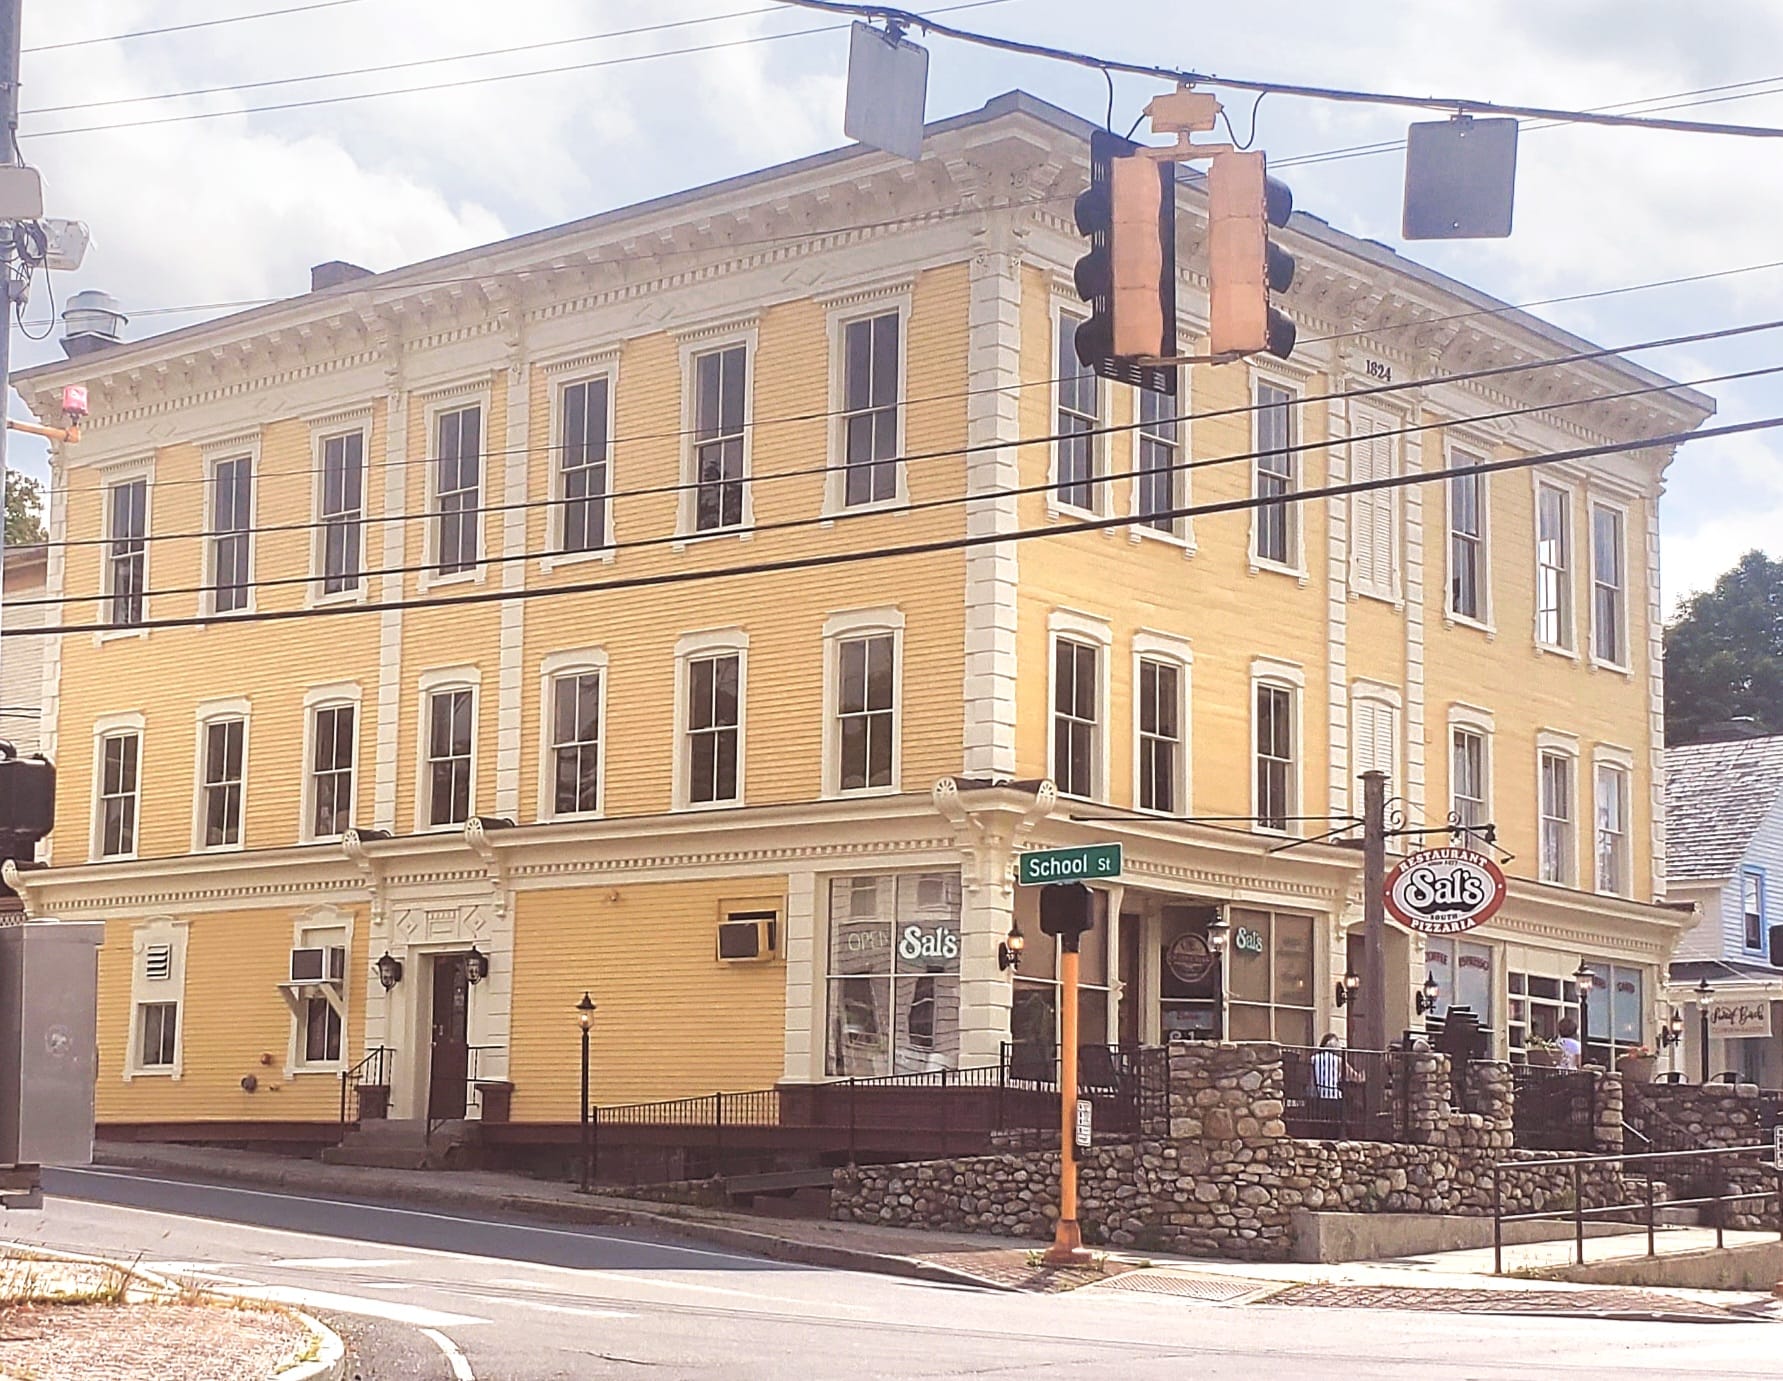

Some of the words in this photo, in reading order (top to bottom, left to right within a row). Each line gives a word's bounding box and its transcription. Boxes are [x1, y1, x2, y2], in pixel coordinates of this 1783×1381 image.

[1366, 360, 1391, 381] 1824
[1029, 854, 1087, 877] School
[1098, 858, 1111, 871] St
[1399, 849, 1488, 872] RESTAURANT
[1404, 868, 1484, 911] Sal's
[1411, 918, 1476, 933] PIZZARIA
[848, 930, 890, 951] OPEN
[899, 925, 958, 959] Sal's
[1236, 926, 1263, 952] Sal's
